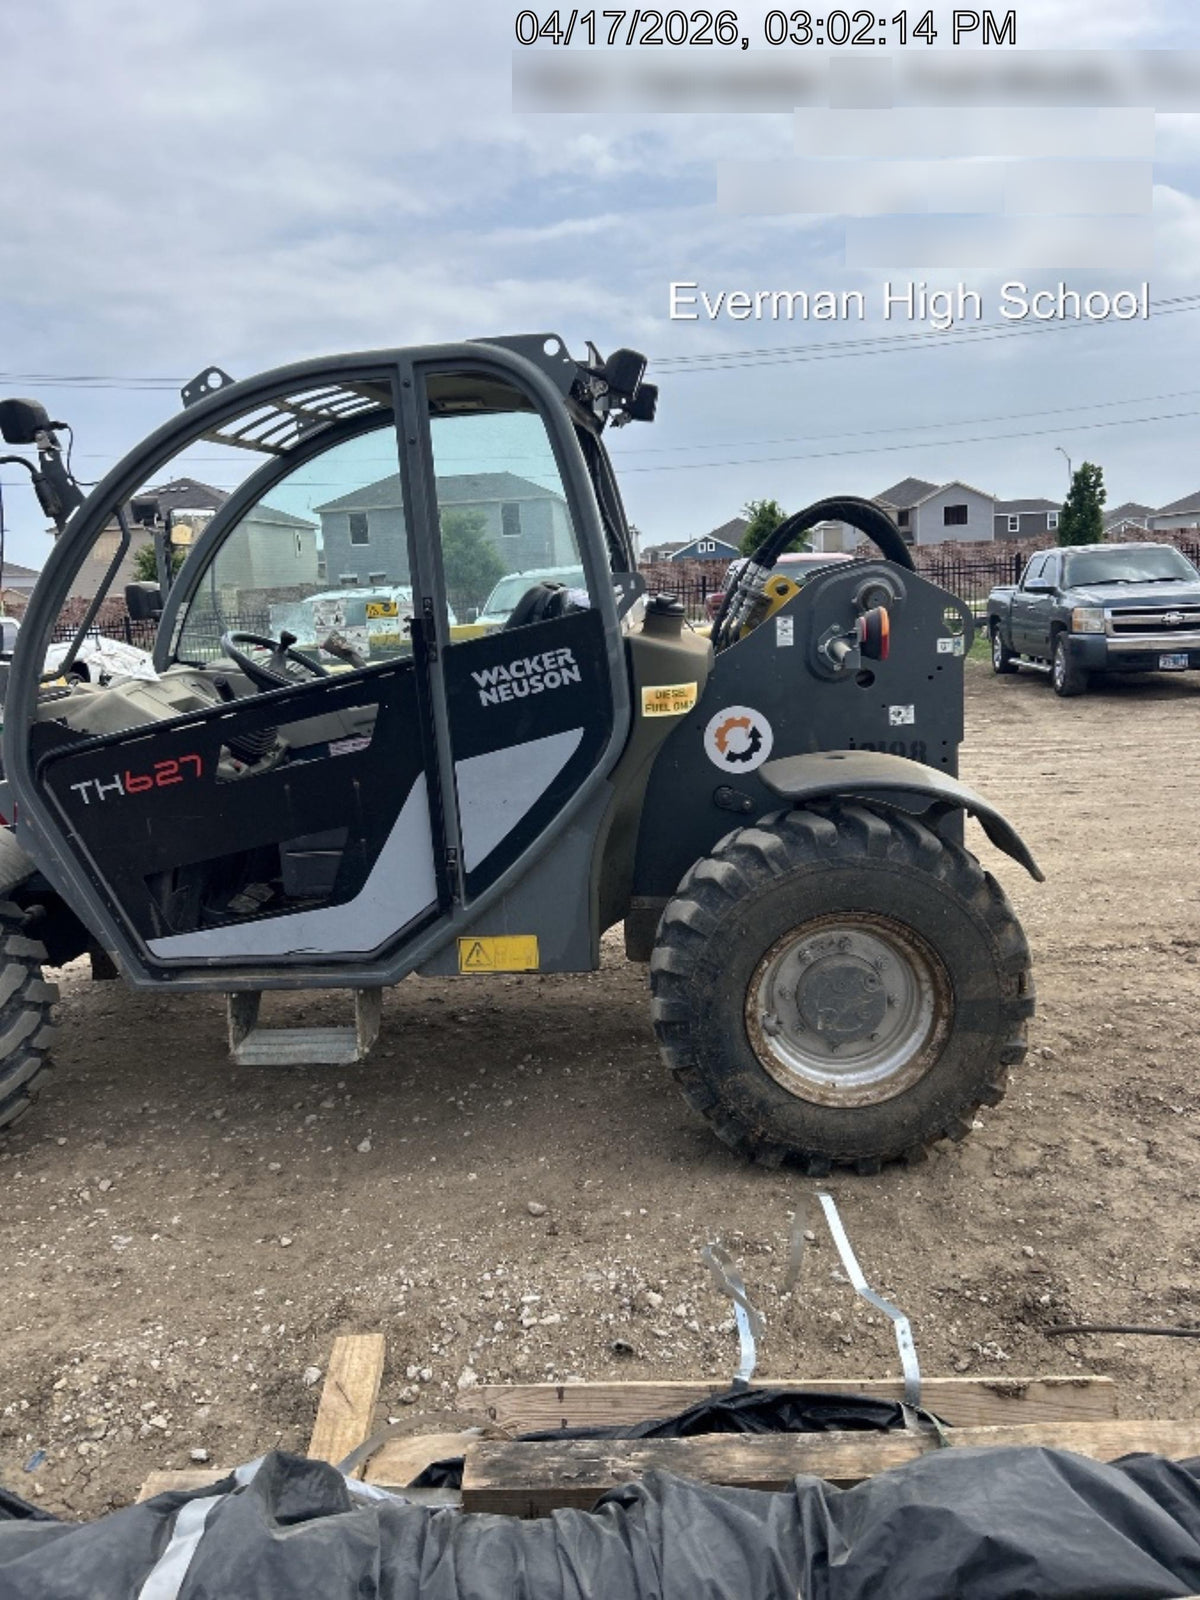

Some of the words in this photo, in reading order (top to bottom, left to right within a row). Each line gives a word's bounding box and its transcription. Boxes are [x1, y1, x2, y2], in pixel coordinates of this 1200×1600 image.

[471, 647, 577, 688] WACKER
[478, 665, 582, 707] NEUSON
[645, 702, 671, 713] FUEL
[70, 754, 203, 804] TH627
